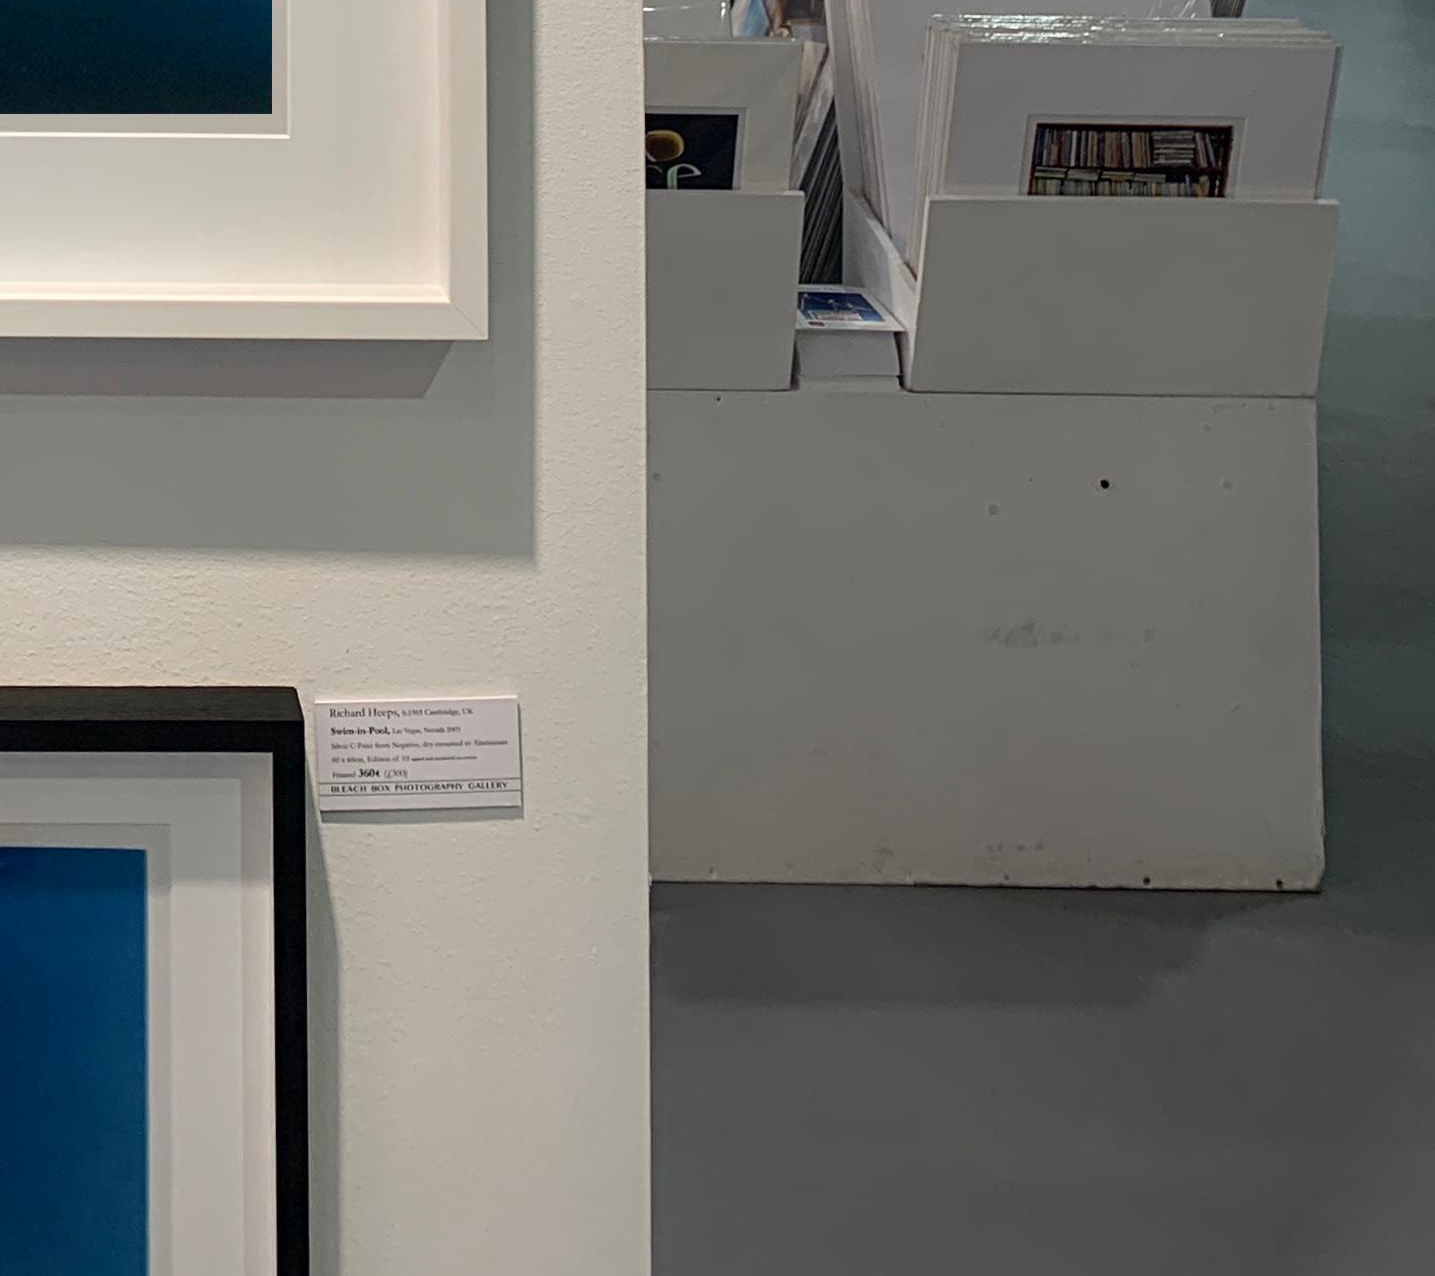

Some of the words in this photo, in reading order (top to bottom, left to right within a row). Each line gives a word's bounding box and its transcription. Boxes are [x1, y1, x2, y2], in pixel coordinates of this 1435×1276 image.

[330, 708, 365, 719] Richard
[368, 708, 401, 720] Heeps,
[330, 726, 391, 736] Swim-in-Pool,
[331, 784, 367, 793] BLEACH
[371, 783, 390, 792] BOX
[395, 782, 462, 792] PHOTOGRAPHY
[468, 781, 508, 790] GALLERY
